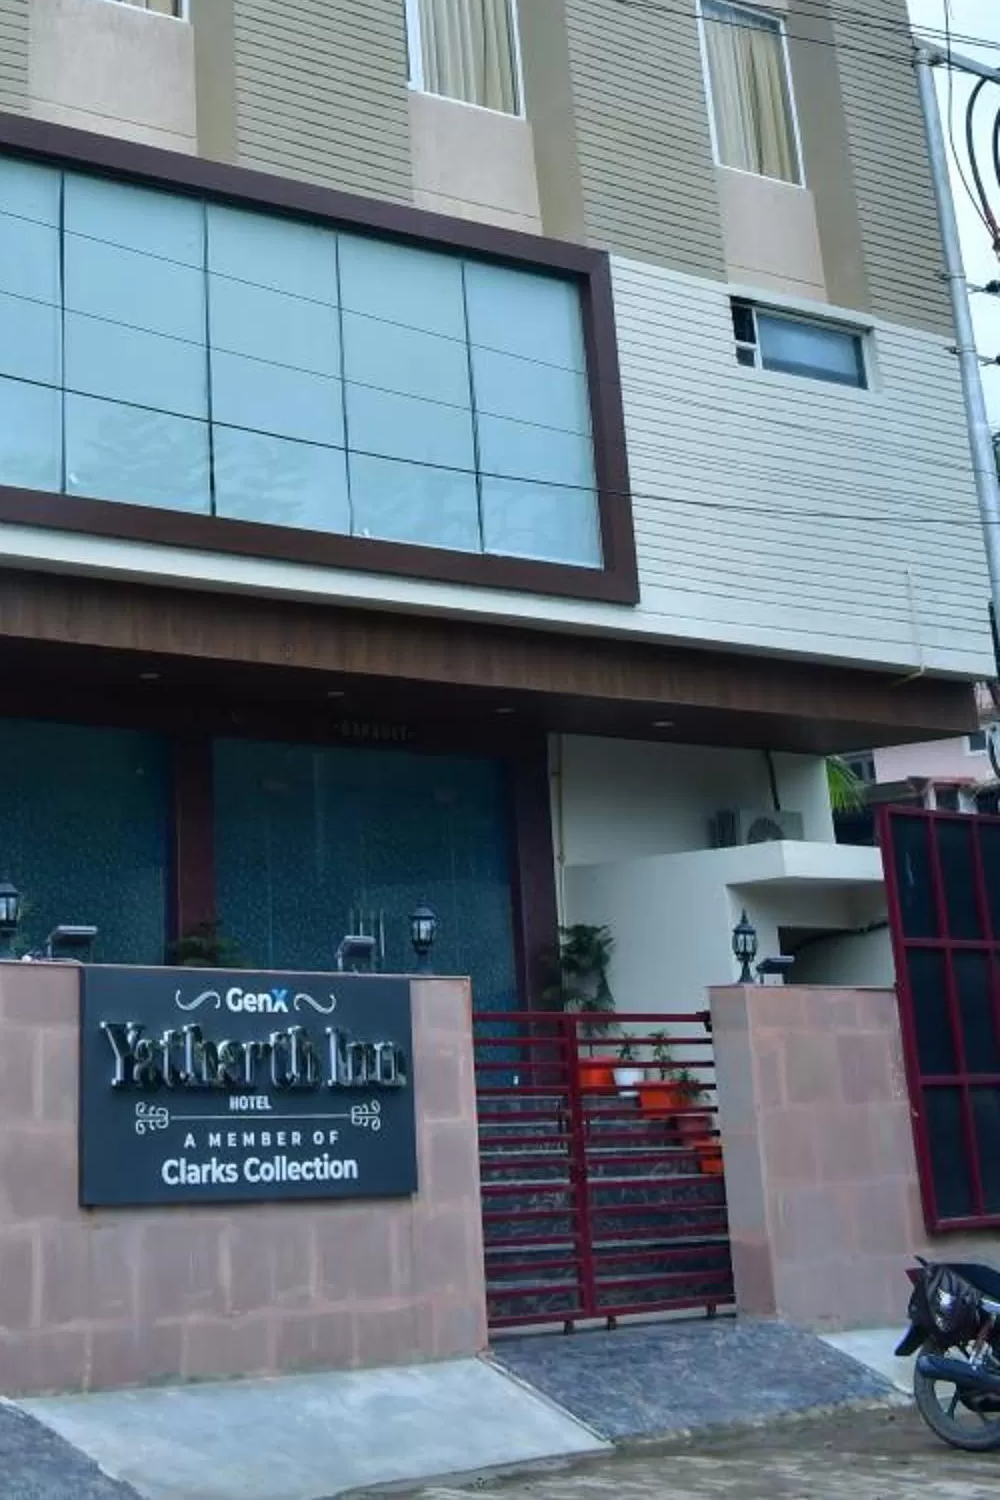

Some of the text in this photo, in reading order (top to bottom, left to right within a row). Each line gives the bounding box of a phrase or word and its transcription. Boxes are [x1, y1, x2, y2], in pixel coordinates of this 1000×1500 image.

[226, 987, 289, 1013] GenX
[100, 1021, 406, 1087] Yatharth Inn
[229, 1096, 271, 1111] HOTEL
[184, 1131, 339, 1148] A MEMBER OF
[161, 1154, 358, 1185] Clarks Collection
